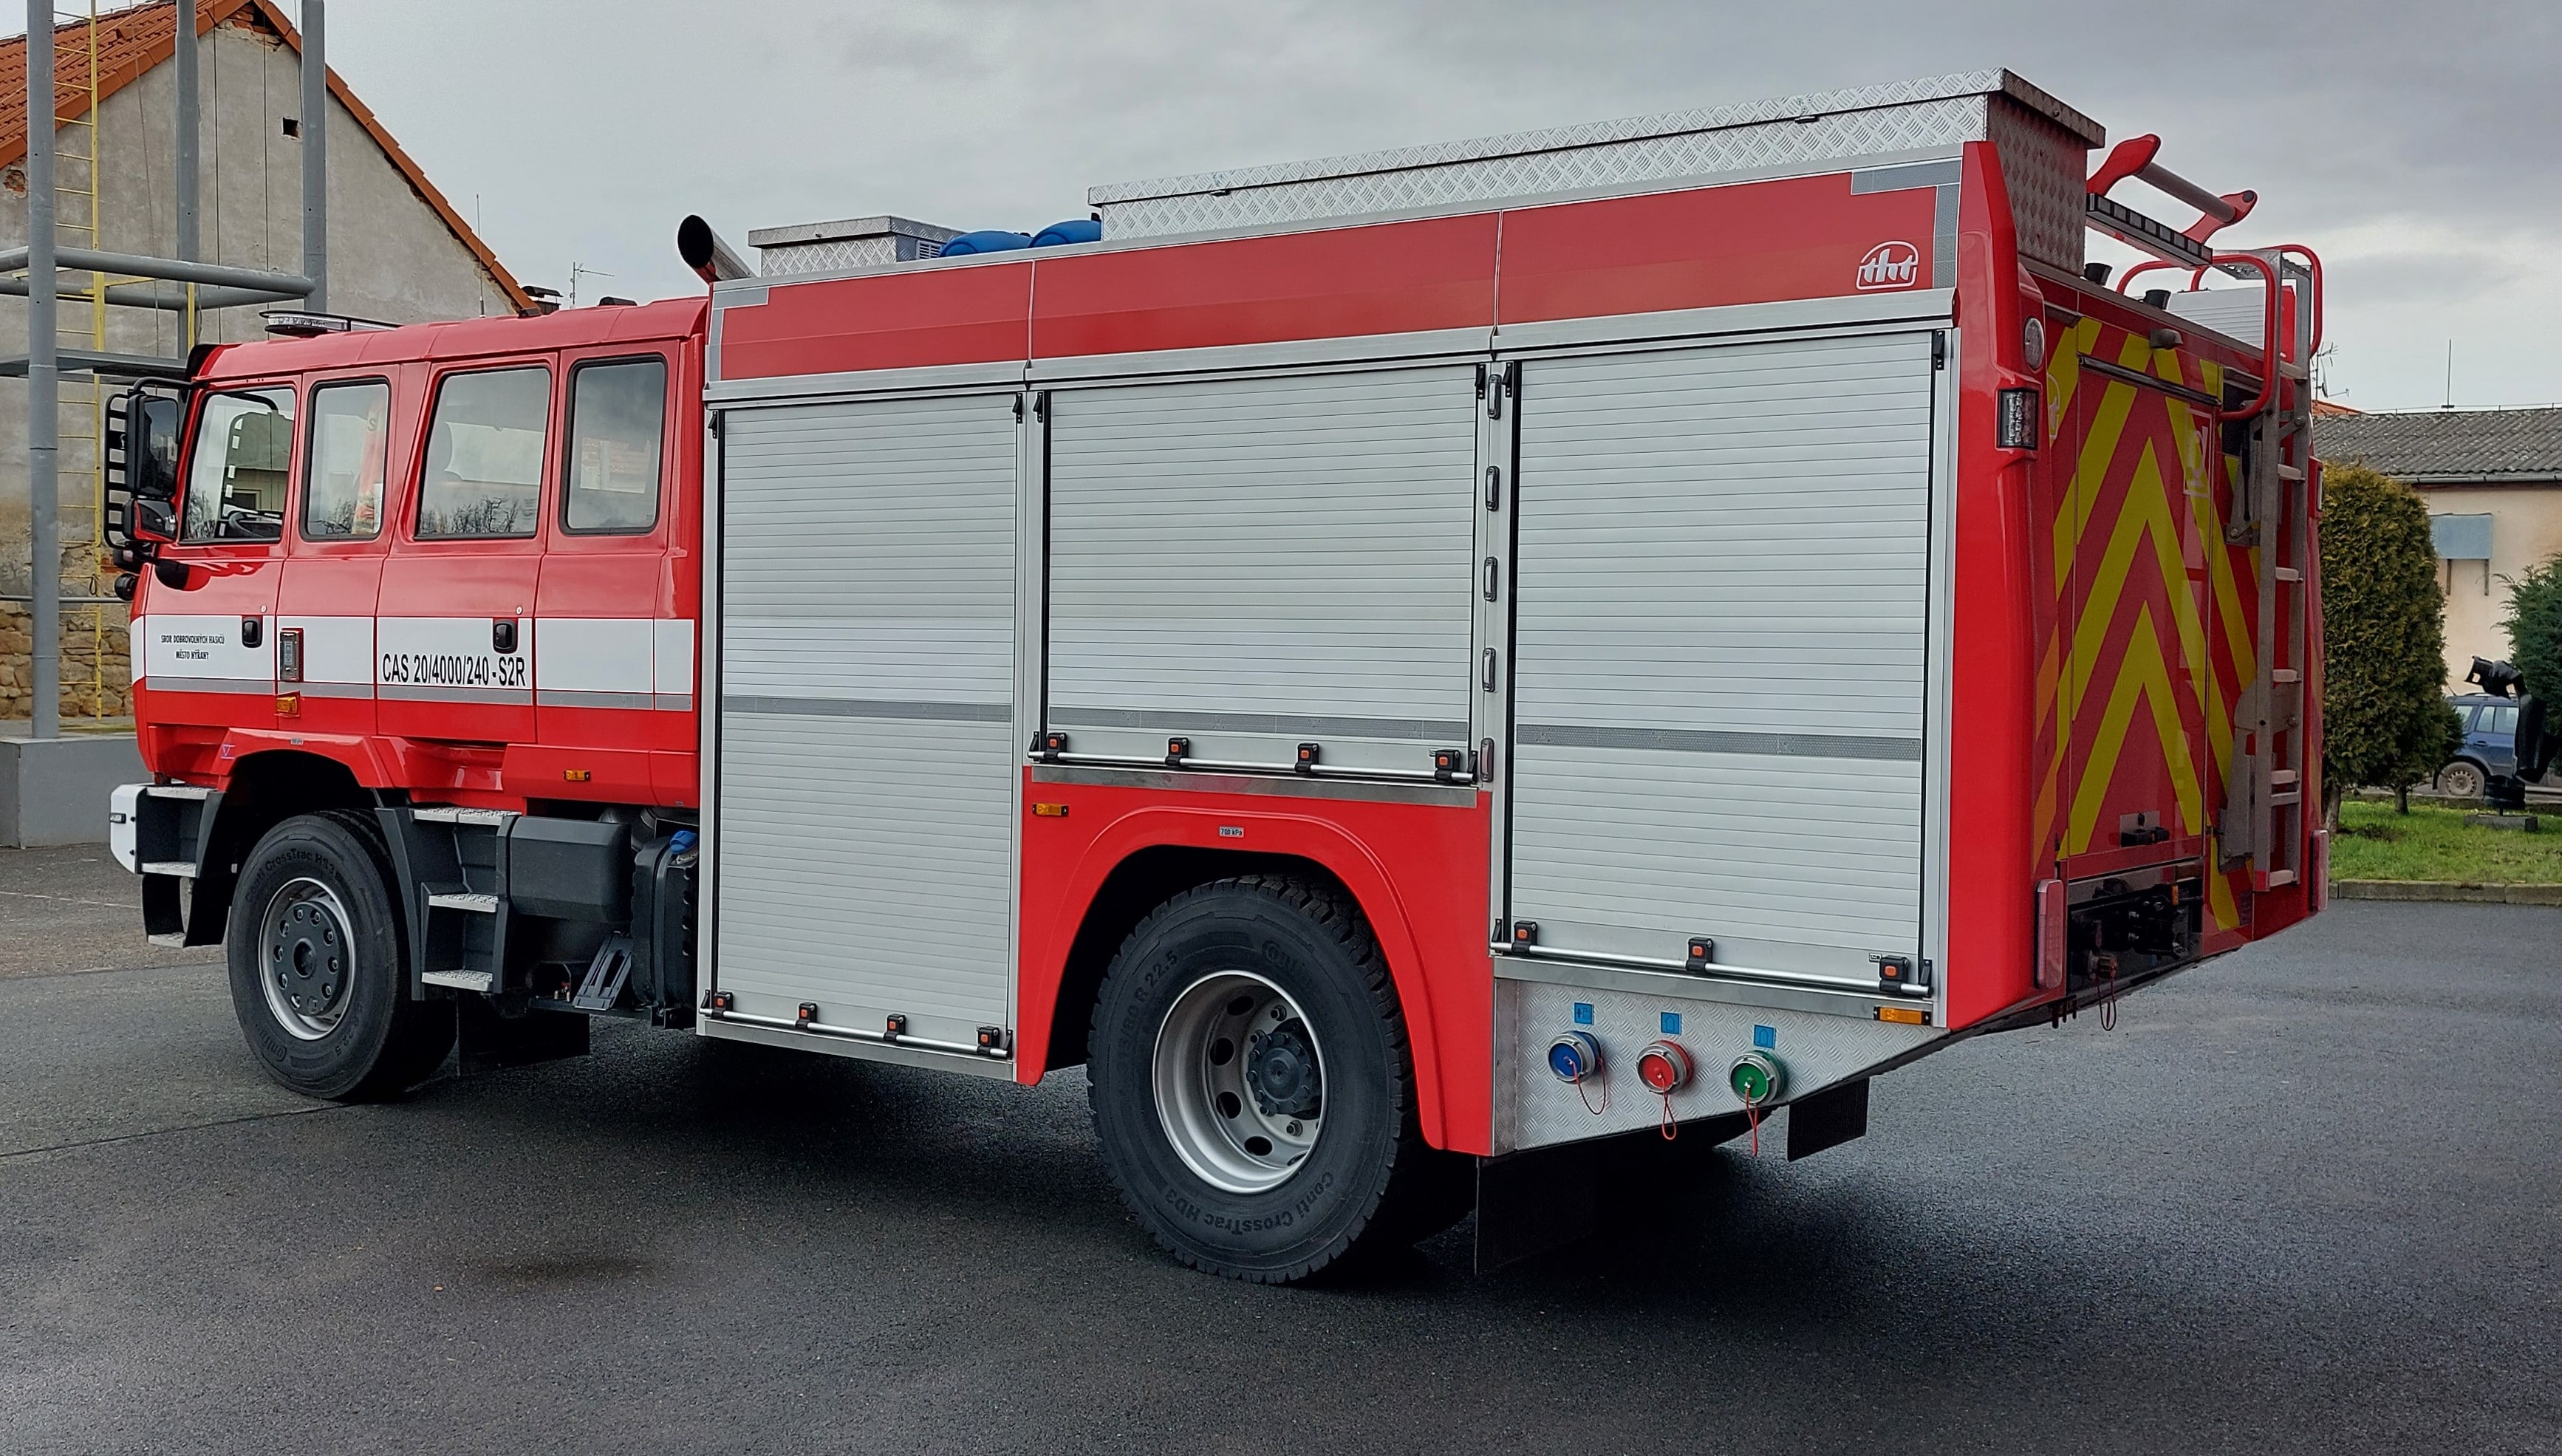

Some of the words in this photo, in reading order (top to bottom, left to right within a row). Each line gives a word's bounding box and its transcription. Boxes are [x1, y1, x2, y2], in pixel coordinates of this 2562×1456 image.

[1859, 247, 1917, 283] tht
[382, 653, 409, 683] CAS
[1165, 1188, 1202, 1223] HD3
[1295, 1172, 1334, 1219] Conti
[1203, 1211, 1294, 1237] CrossTrac
